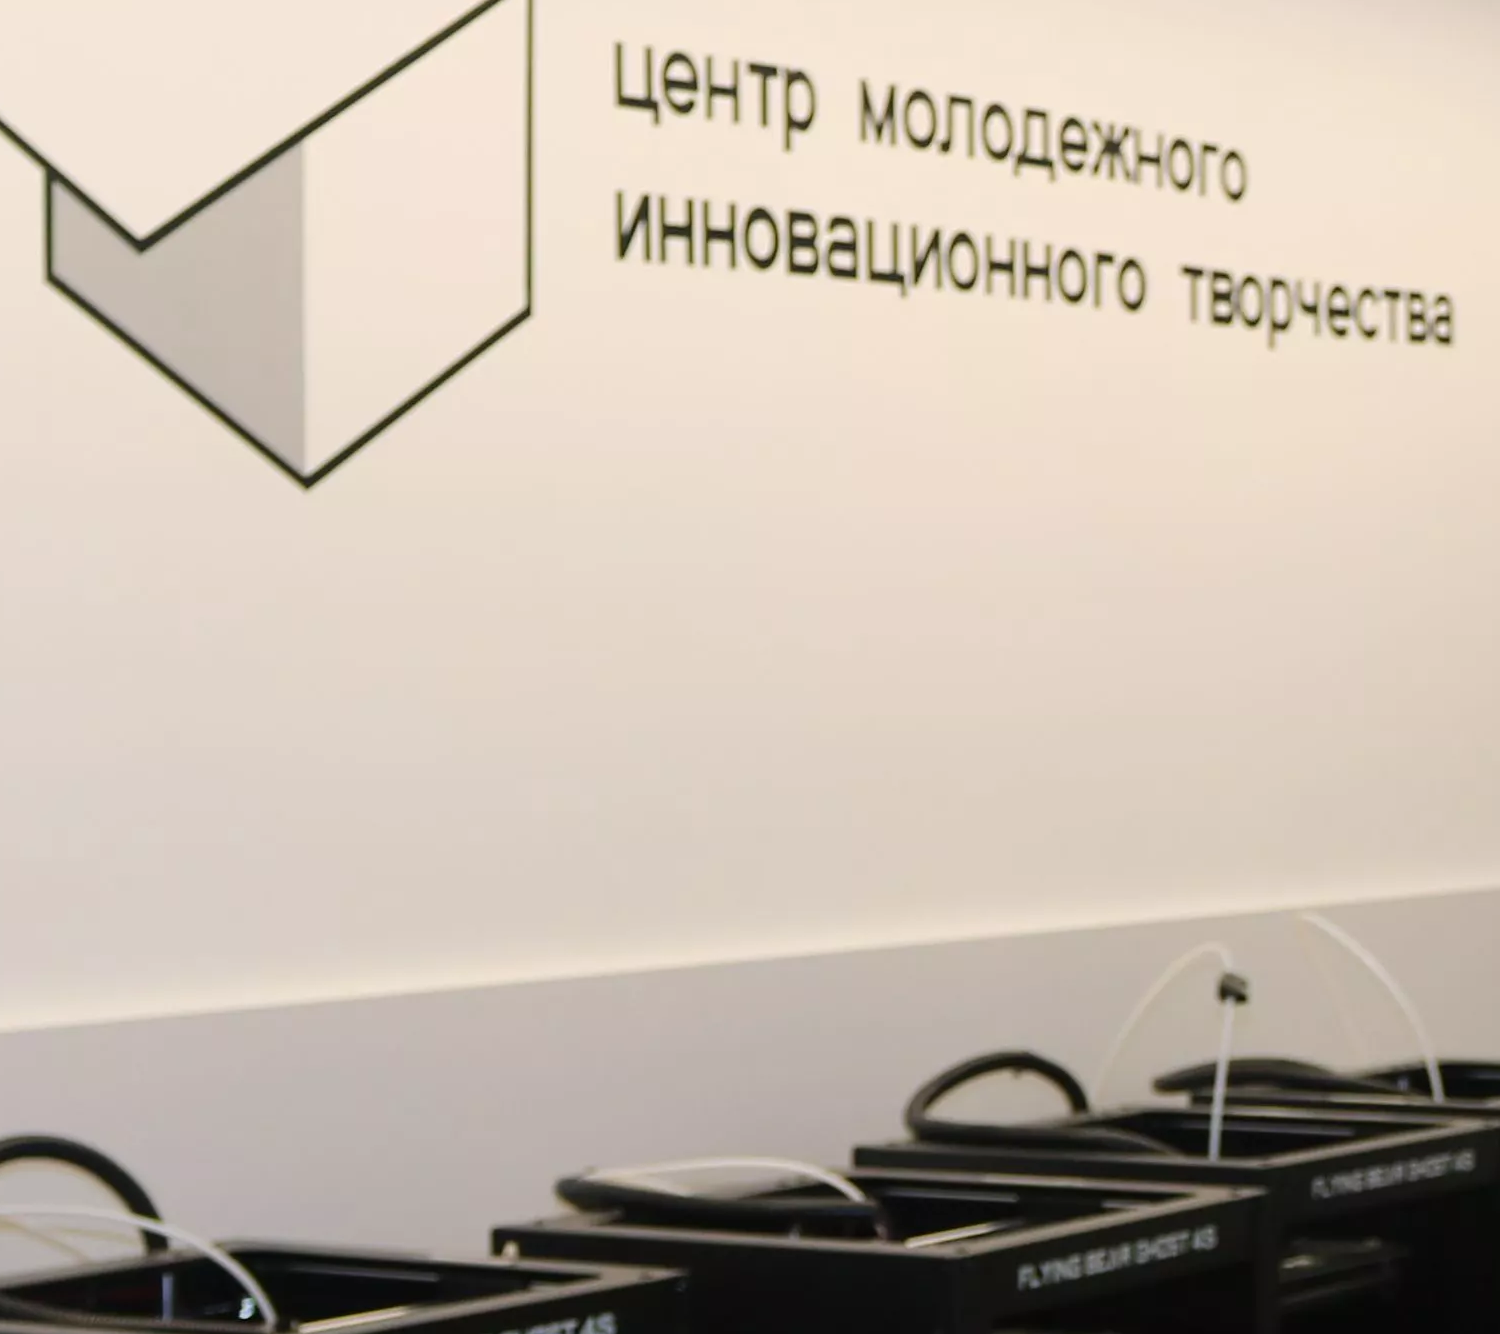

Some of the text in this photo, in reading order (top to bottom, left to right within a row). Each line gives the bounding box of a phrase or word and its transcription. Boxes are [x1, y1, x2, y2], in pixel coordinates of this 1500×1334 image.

[613, 41, 1249, 202] центр молодежного
[614, 189, 1457, 349] инновационного творчества
